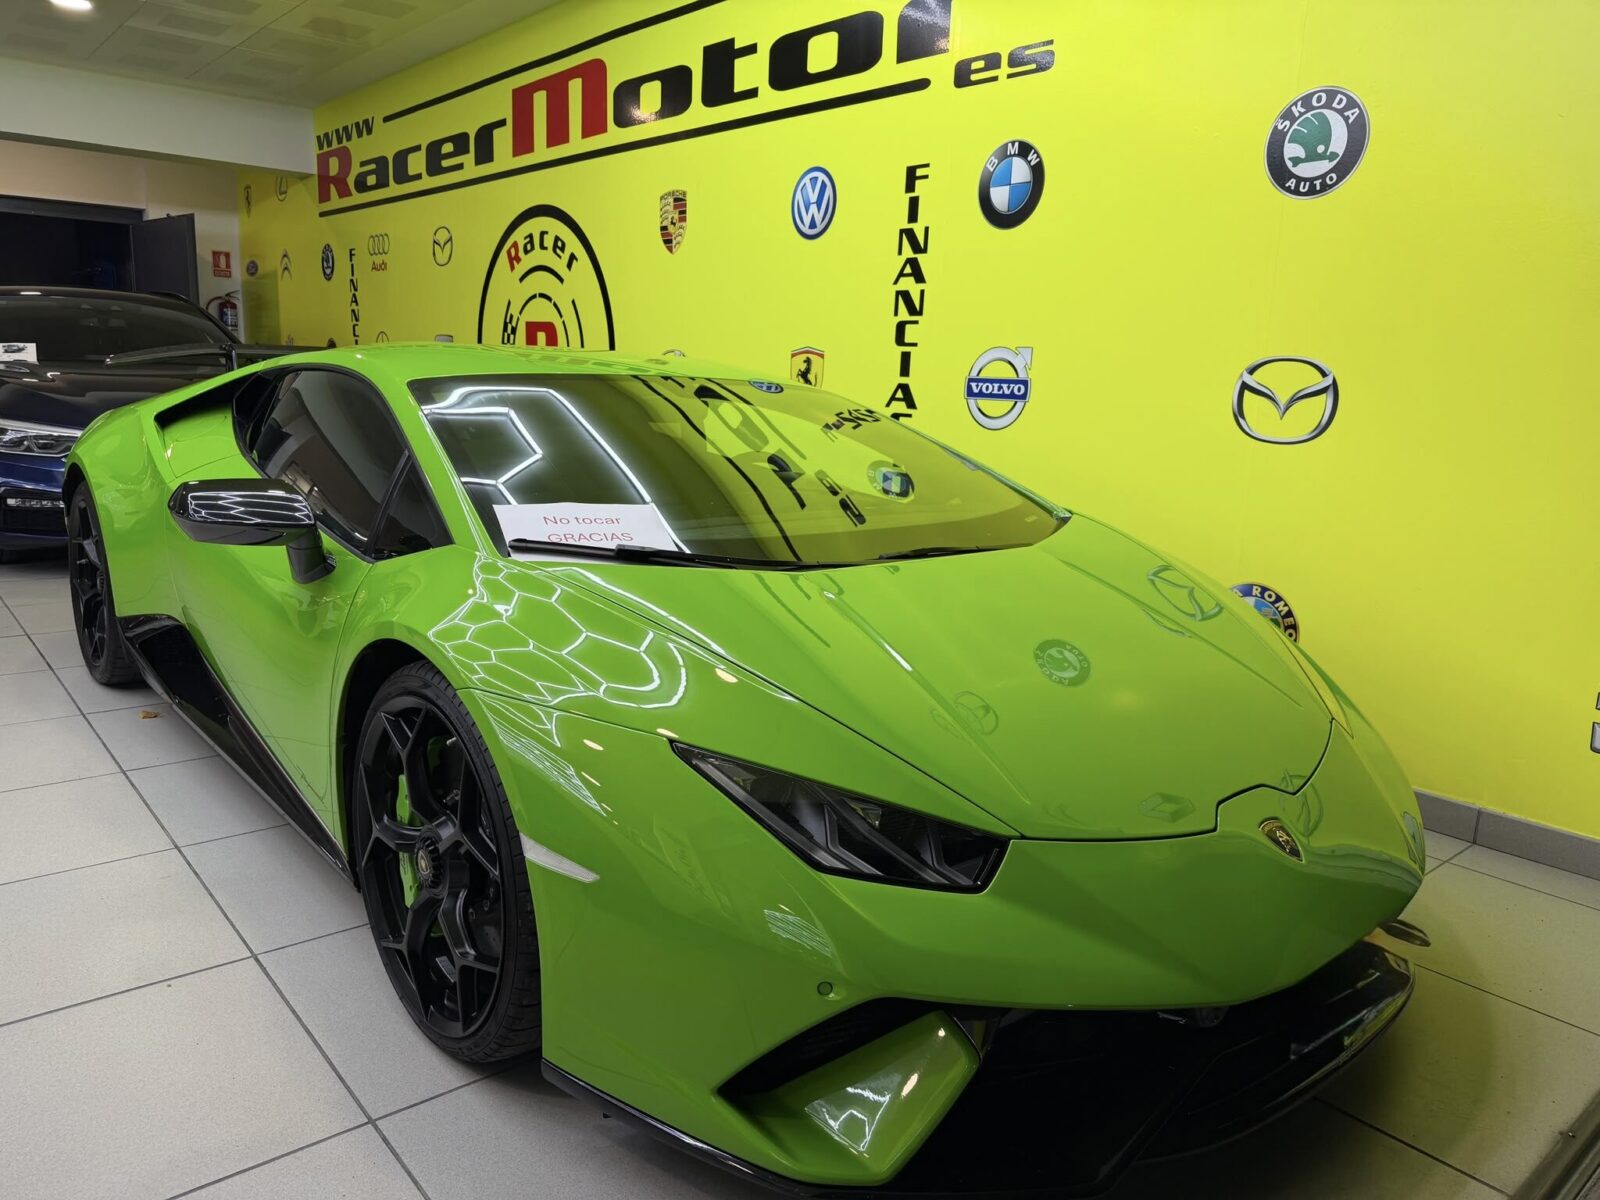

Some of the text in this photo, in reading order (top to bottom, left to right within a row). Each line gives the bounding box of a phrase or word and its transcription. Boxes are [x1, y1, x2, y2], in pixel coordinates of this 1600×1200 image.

[317, 116, 375, 151] www
[986, 141, 1040, 172] BMW
[1285, 173, 1337, 193] AUTO
[506, 230, 578, 273] Racer
[371, 260, 388, 272] Audi
[969, 381, 1026, 395] VOLVO
[543, 515, 622, 525] No tocar
[547, 532, 634, 543] GRACIAS
[1252, 585, 1297, 642] ROMEO
